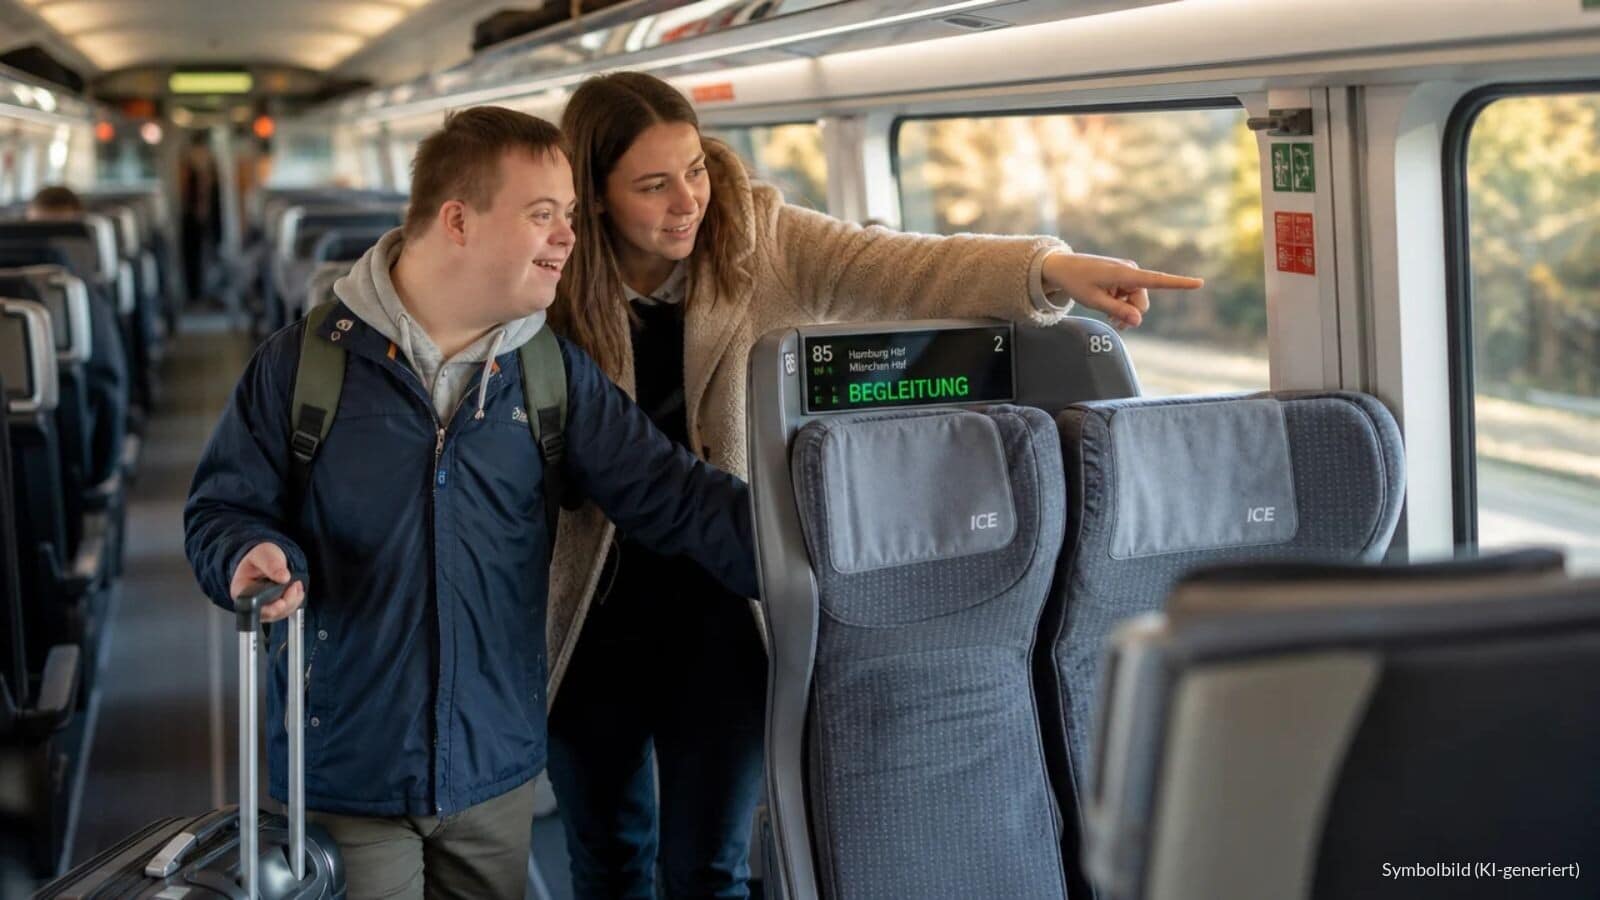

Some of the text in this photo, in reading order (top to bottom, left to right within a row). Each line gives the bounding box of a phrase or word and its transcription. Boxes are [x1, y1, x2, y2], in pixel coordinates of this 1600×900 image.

[993, 335, 1004, 352] 2
[1089, 335, 1113, 353] 85
[812, 345, 833, 362] 85
[848, 376, 969, 403] BEGLEITUNG
[970, 512, 998, 531] ICE
[1247, 506, 1276, 522] ICE
